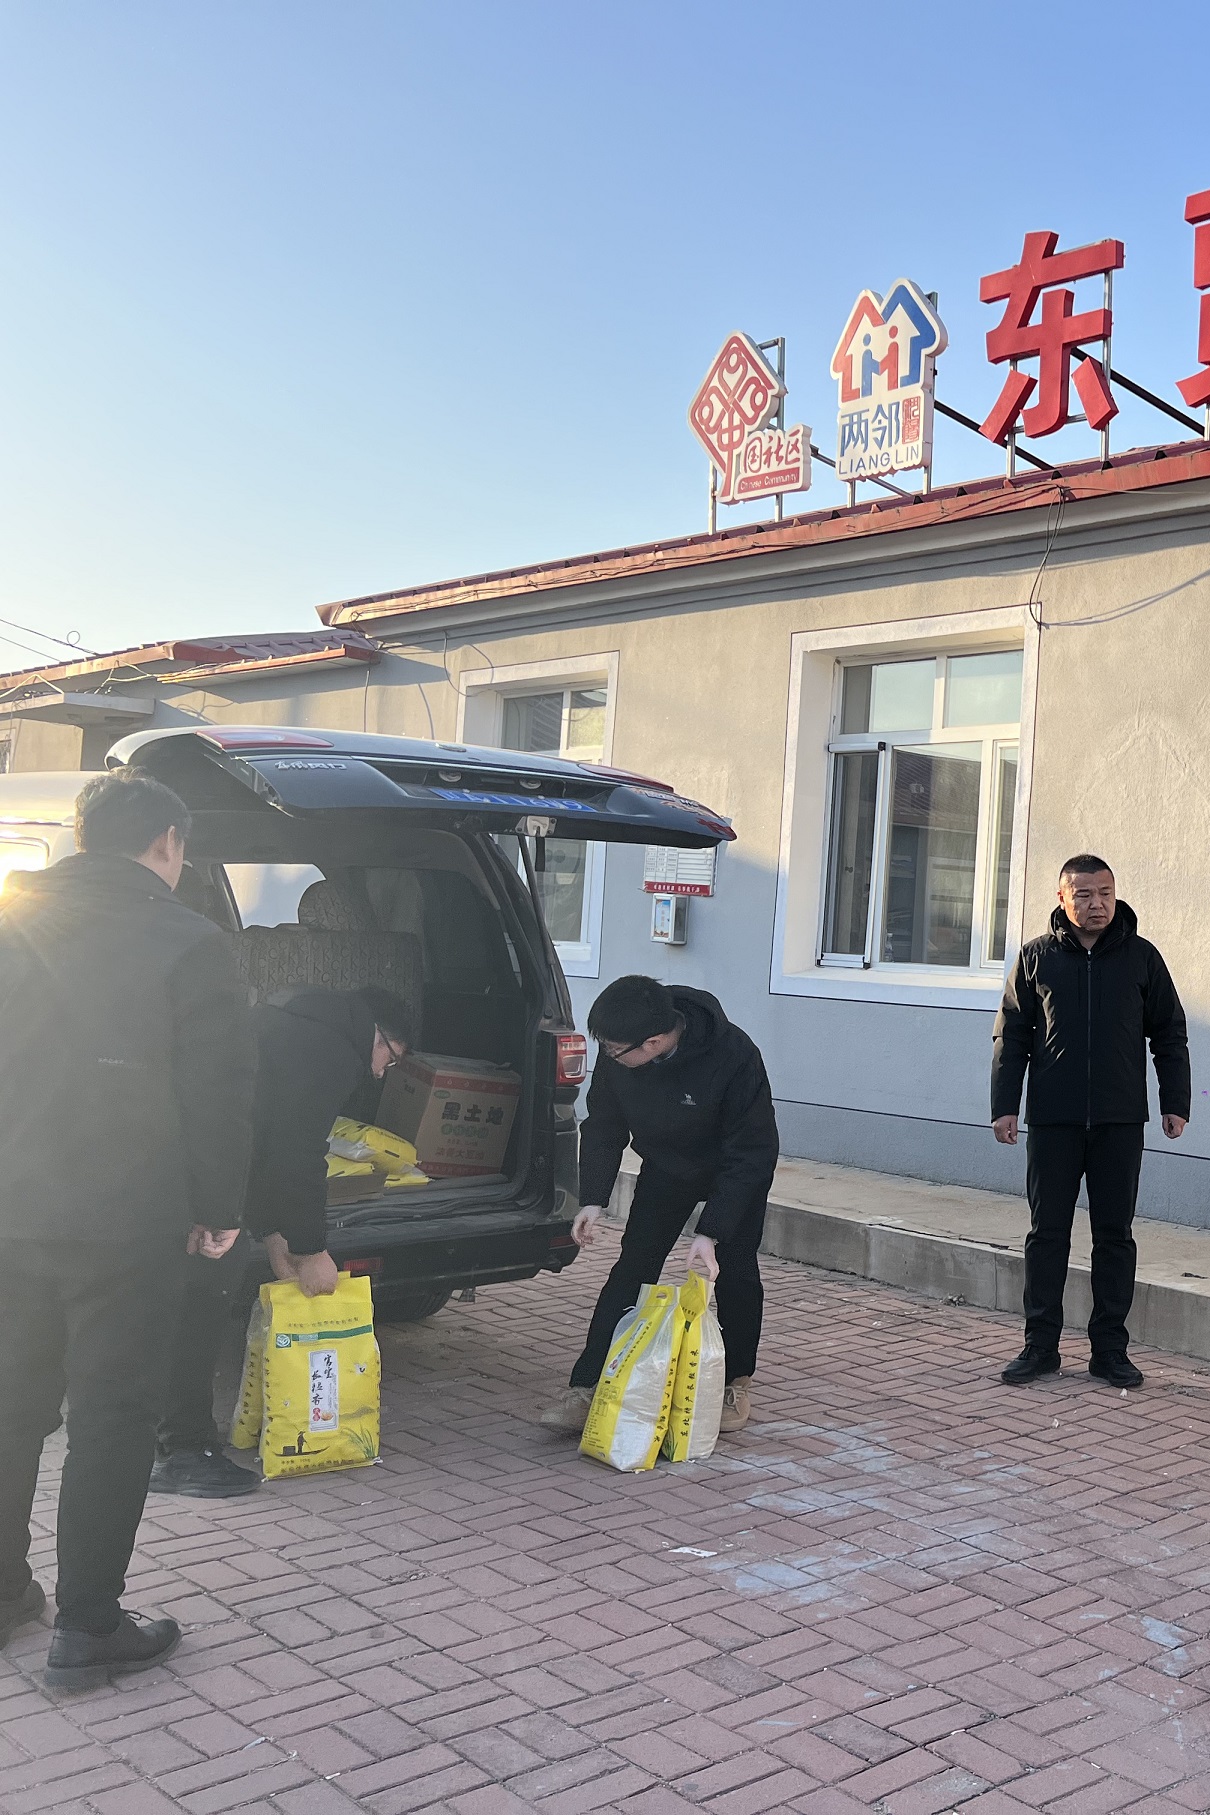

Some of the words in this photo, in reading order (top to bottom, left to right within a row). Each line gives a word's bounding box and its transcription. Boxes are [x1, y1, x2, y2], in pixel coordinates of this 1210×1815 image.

[840, 401, 900, 458] 两邻
[763, 473, 797, 486] Community
[838, 452, 891, 475] LIANG
[895, 444, 919, 465] LIN
[680, 1349, 699, 1437] 东北特产长粒香米
